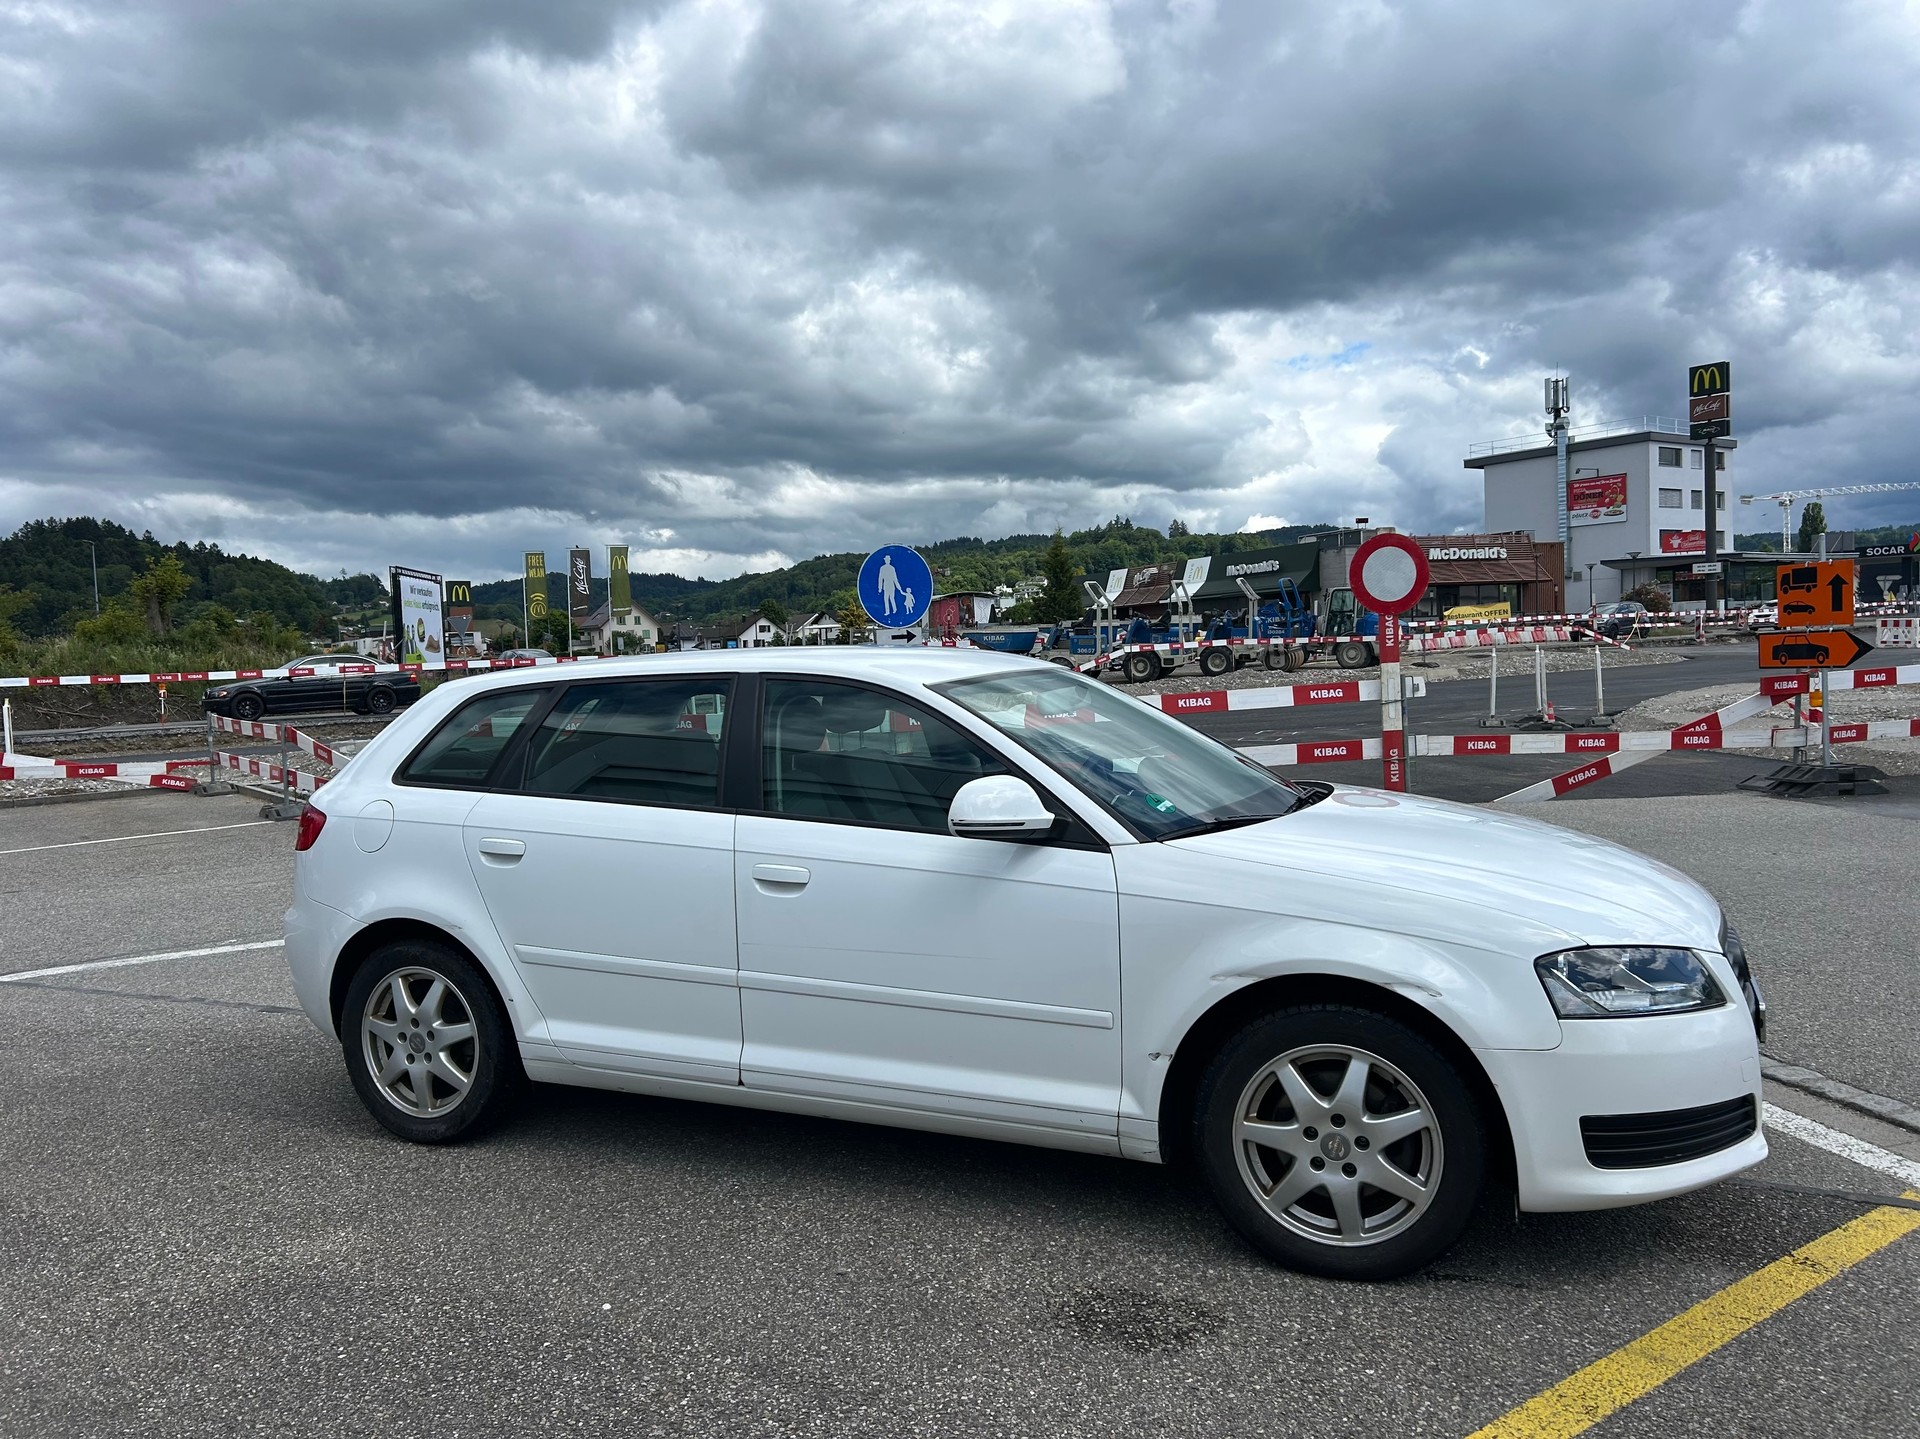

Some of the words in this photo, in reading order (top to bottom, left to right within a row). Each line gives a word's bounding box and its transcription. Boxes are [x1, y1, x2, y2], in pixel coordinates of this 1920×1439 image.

[1428, 546, 1507, 560] McDonald's
[1866, 545, 1905, 556] SOCAR
[528, 555, 543, 566] FREE
[528, 568, 545, 578] WLAN
[1226, 560, 1279, 576] McDonald's
[1483, 609, 1508, 617] OFFEN
[1864, 672, 1886, 682] KIBAG
[1774, 680, 1798, 690] KIBAG
[1310, 688, 1343, 699] KIBAG
[1177, 697, 1212, 708] KIBAG
[1833, 728, 1857, 738] KIBAG
[1467, 740, 1496, 750] KIBAG
[1578, 738, 1606, 748] KIBAG
[1683, 736, 1710, 745] KIBAG
[1314, 746, 1347, 757] KIBAG
[1390, 748, 1399, 782] KIBAG
[1567, 767, 1598, 785] KIBAG
[162, 778, 186, 787] KIBAG
